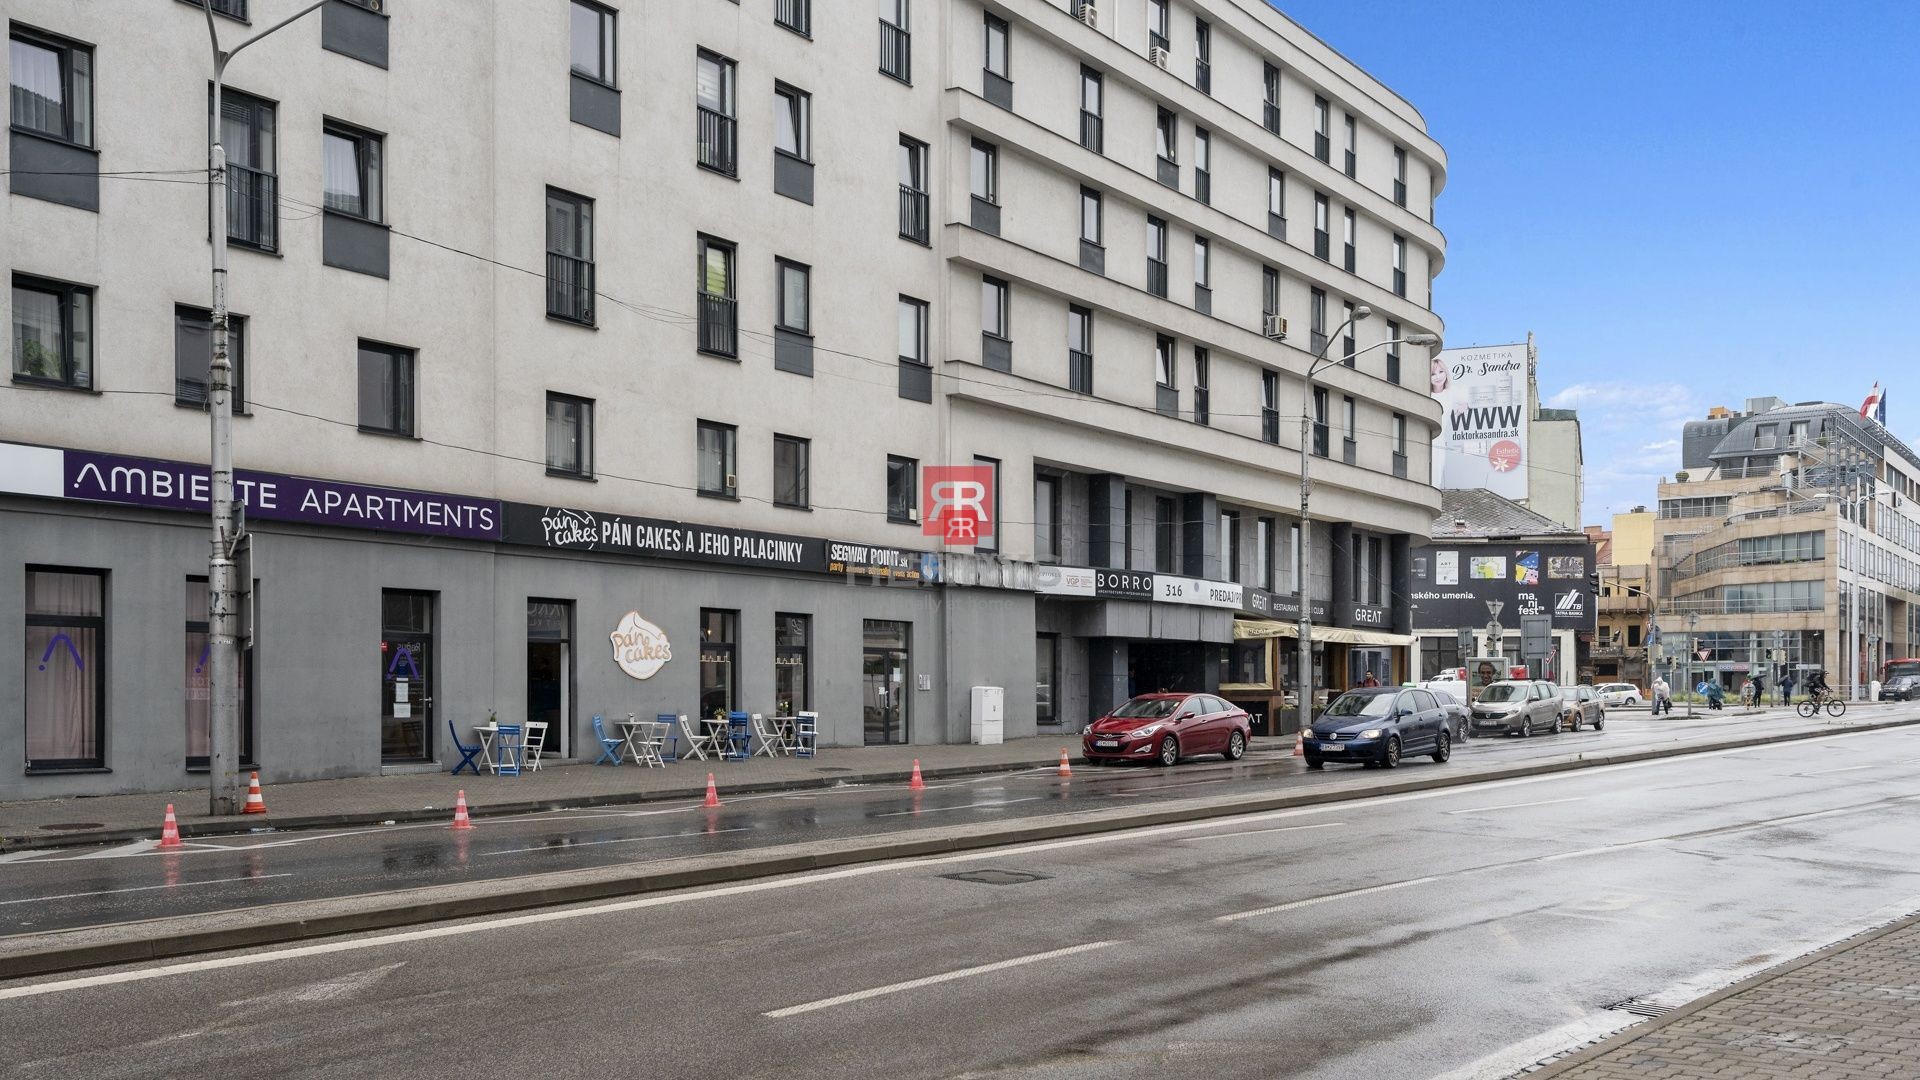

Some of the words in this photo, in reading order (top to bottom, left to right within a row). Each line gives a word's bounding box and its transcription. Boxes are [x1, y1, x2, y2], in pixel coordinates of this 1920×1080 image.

[1461, 352, 1513, 361] KOZMETIKA
[1452, 363, 1473, 380] Dr.
[1478, 360, 1521, 376] Sandra
[1452, 428, 1519, 441] doktorkasandra.sk
[73, 462, 277, 509] AMBIETE
[300, 488, 494, 531] APARTMENTS
[554, 520, 599, 545] cakes
[602, 517, 632, 546] PÁN
[636, 525, 681, 552] CAKES
[685, 530, 695, 553] A
[698, 532, 730, 556] JEHO
[734, 536, 803, 563] PALACINKY
[831, 544, 868, 564] SEGWAY
[1097, 573, 1152, 591] BORRO
[1165, 584, 1183, 597] 316
[1442, 592, 1476, 600] umenia.
[1273, 603, 1299, 612] RESTAURANT
[1313, 606, 1324, 615] CLUB
[1355, 608, 1382, 624] GREAT
[625, 636, 671, 663] cakes
